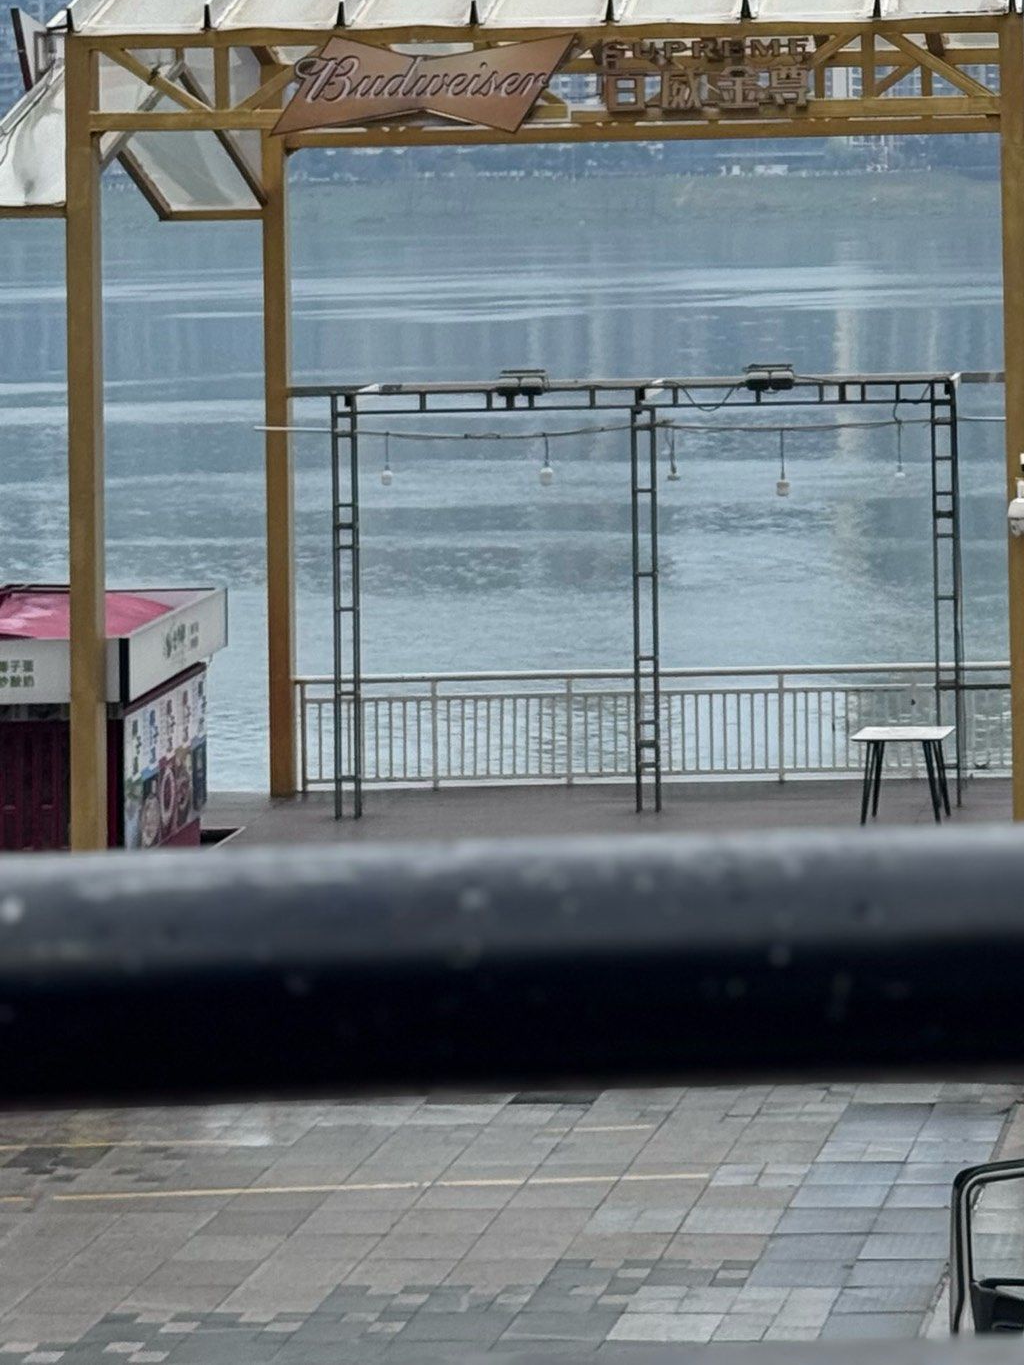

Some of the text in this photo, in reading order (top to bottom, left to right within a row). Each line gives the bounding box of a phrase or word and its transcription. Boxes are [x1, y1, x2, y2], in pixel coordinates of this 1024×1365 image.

[603, 38, 809, 64] SUPREME
[294, 54, 549, 103] Budweiser
[604, 62, 809, 111] 百威金尊
